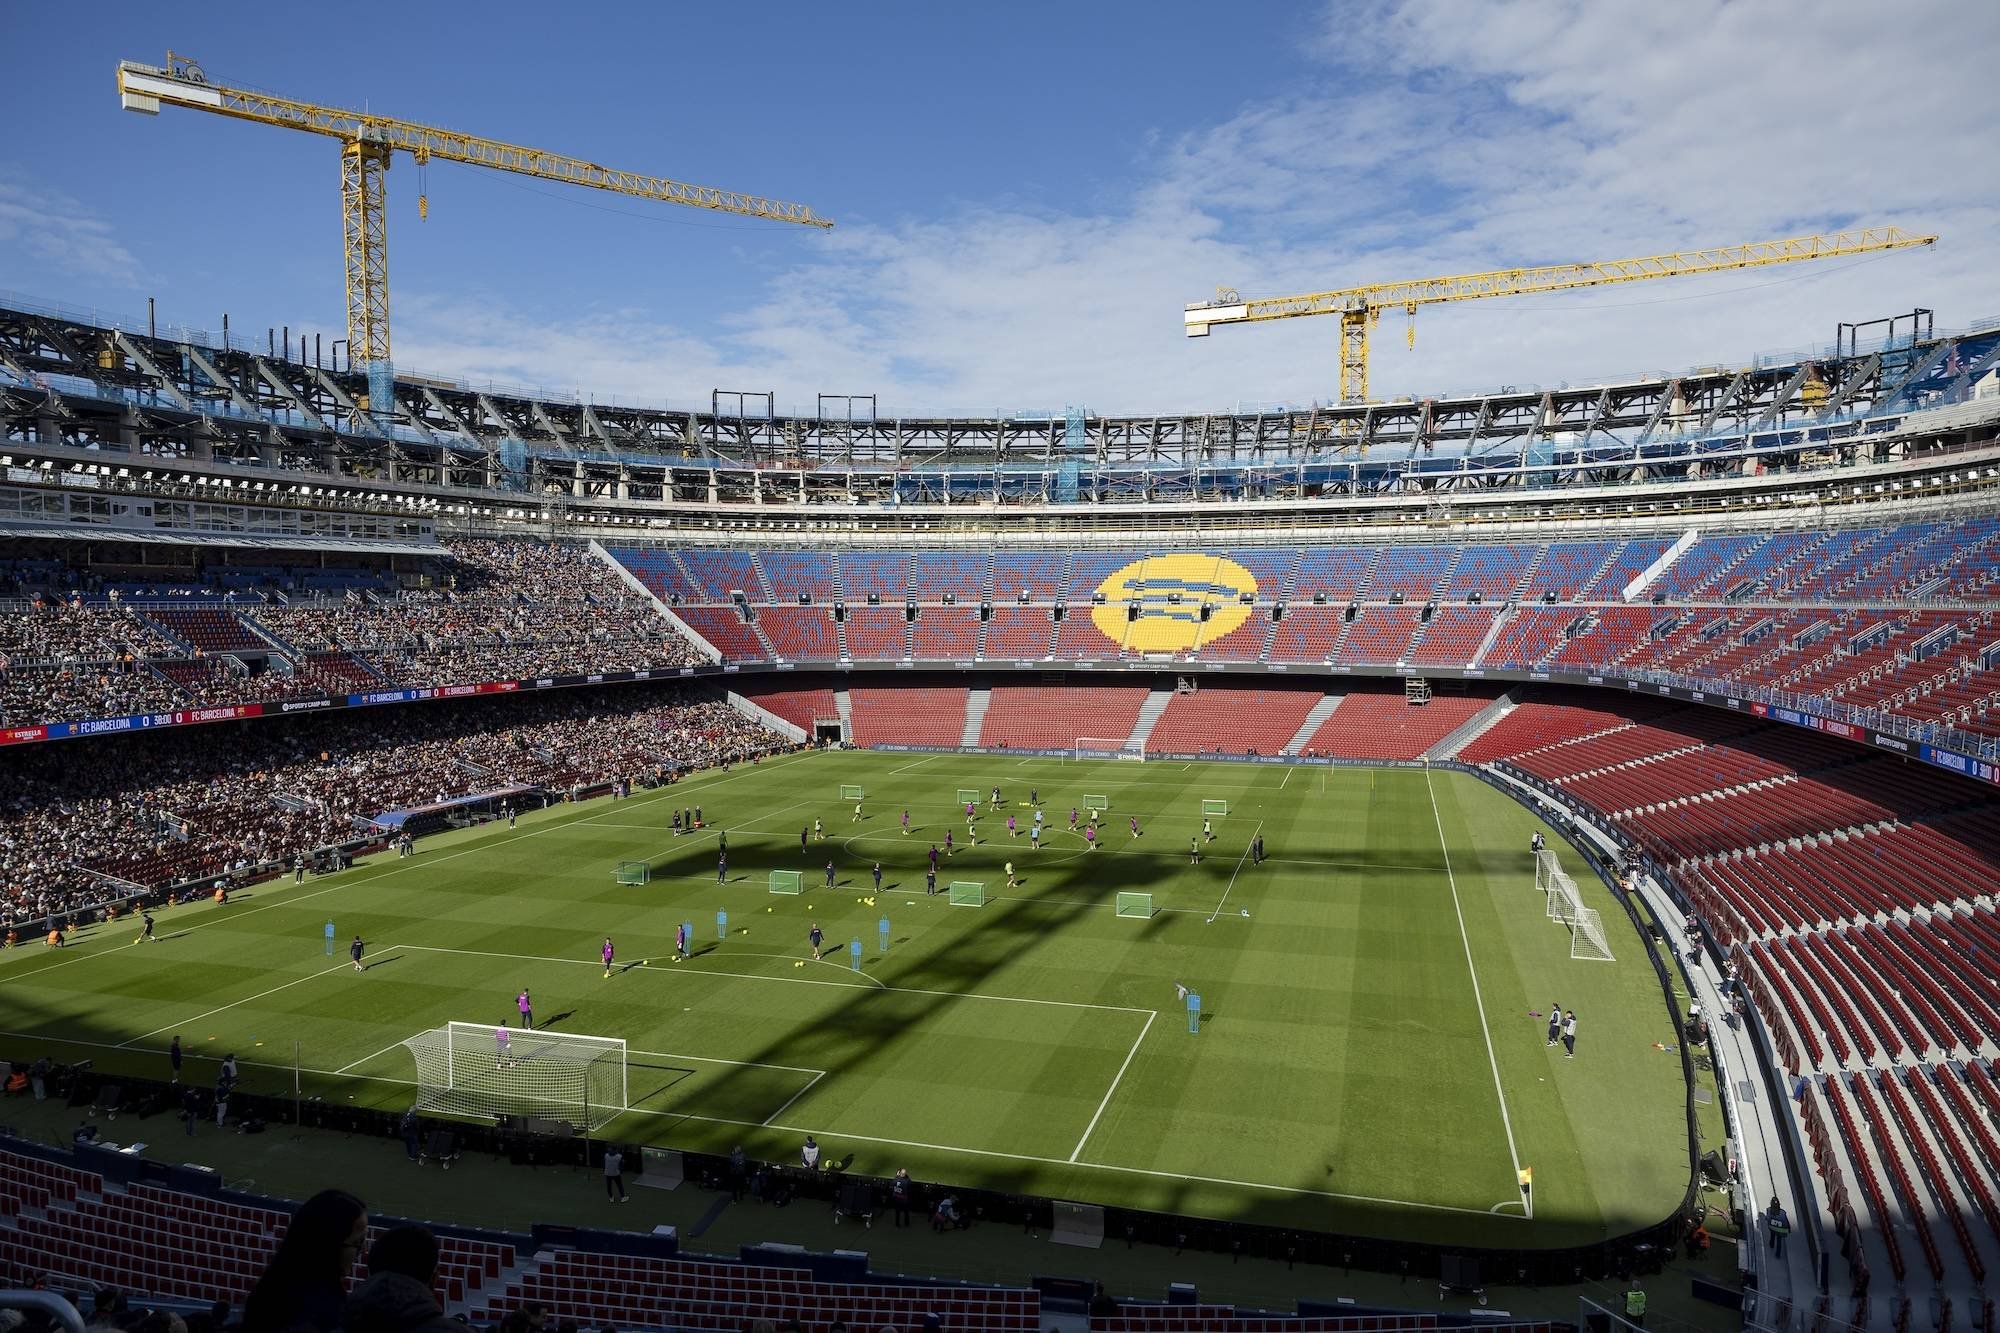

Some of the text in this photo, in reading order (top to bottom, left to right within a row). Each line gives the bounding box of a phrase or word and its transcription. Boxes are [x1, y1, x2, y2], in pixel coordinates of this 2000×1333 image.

[377, 692, 404, 702] BARCELONA
[176, 712, 183, 723] 0
[192, 708, 235, 721] FC BARCELONA
[81, 718, 131, 733] FC BARCELONA
[143, 716, 150, 726] 0
[15, 730, 42, 738] ESTRELLA
[1973, 761, 1977, 775] 0
